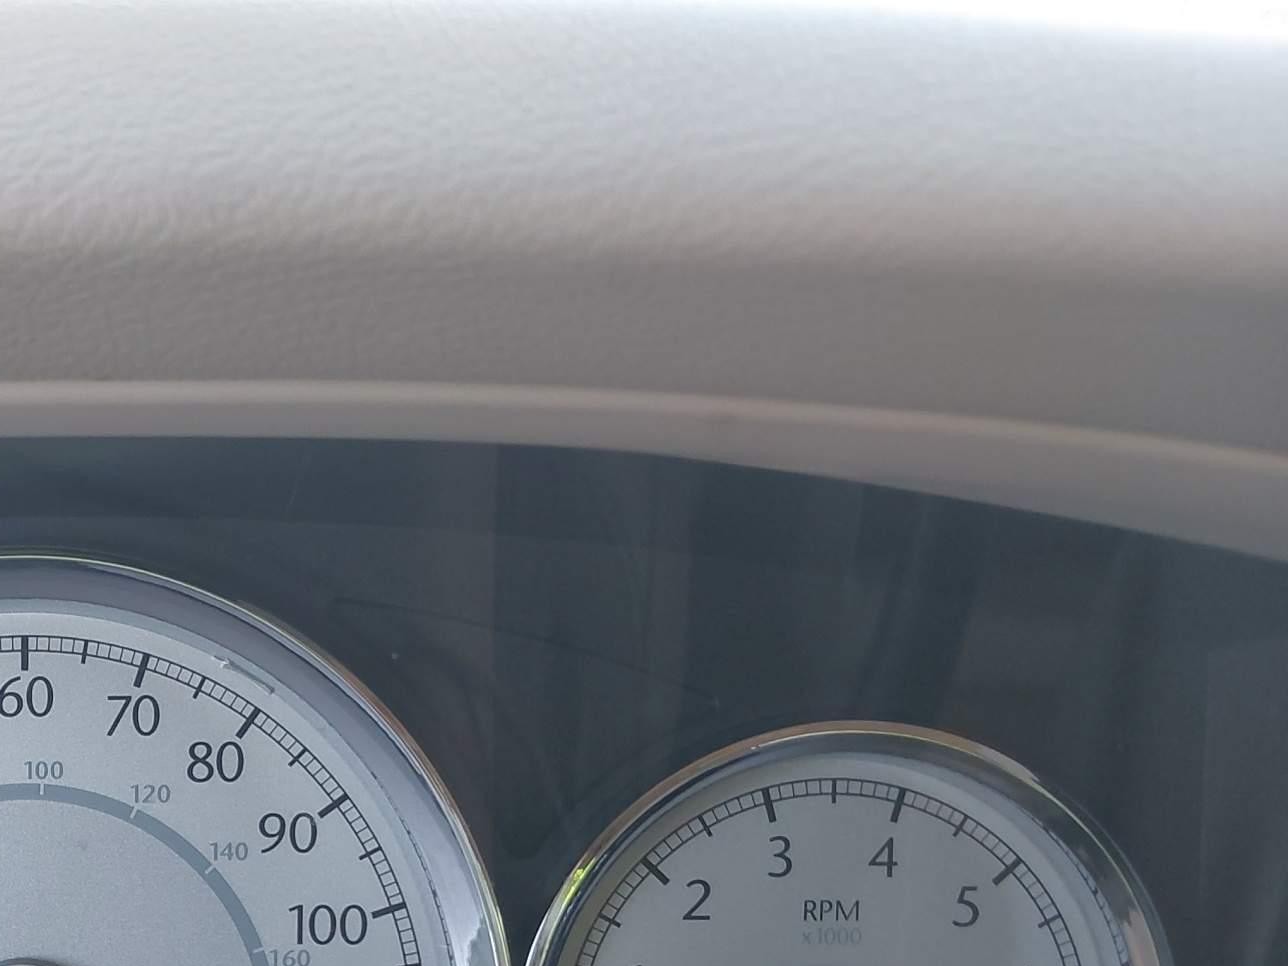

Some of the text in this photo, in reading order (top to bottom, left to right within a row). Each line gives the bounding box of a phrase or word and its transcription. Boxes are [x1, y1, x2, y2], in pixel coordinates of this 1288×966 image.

[107, 695, 160, 736] 70
[25, 761, 63, 779] 100
[187, 742, 244, 782] 80
[131, 785, 171, 803] 120
[209, 843, 248, 861] 140
[259, 813, 317, 853] 90
[768, 836, 792, 877] 3
[868, 837, 898, 877] 4
[683, 880, 710, 920] 2
[804, 900, 859, 921] RPM
[952, 886, 979, 927] 5
[289, 905, 367, 945] 100
